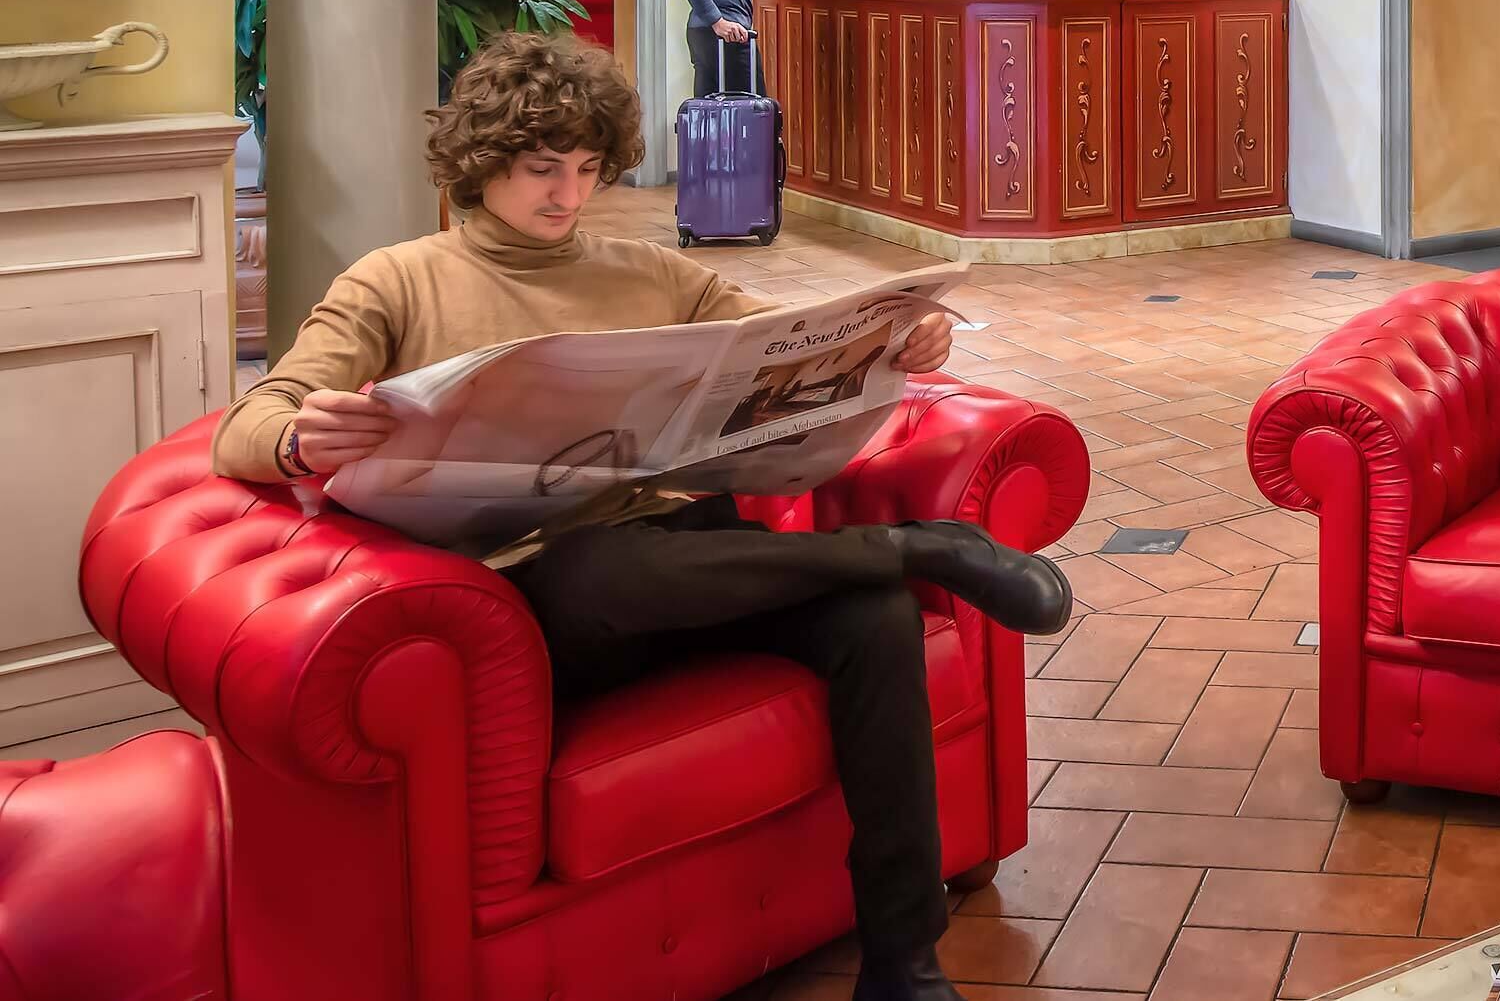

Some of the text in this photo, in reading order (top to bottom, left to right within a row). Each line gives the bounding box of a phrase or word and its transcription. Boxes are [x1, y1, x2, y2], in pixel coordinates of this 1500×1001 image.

[764, 340, 797, 355] The
[798, 333, 834, 349] New
[834, 316, 870, 342] York
[716, 413, 842, 456] Loss of aid bites Afghanistan
